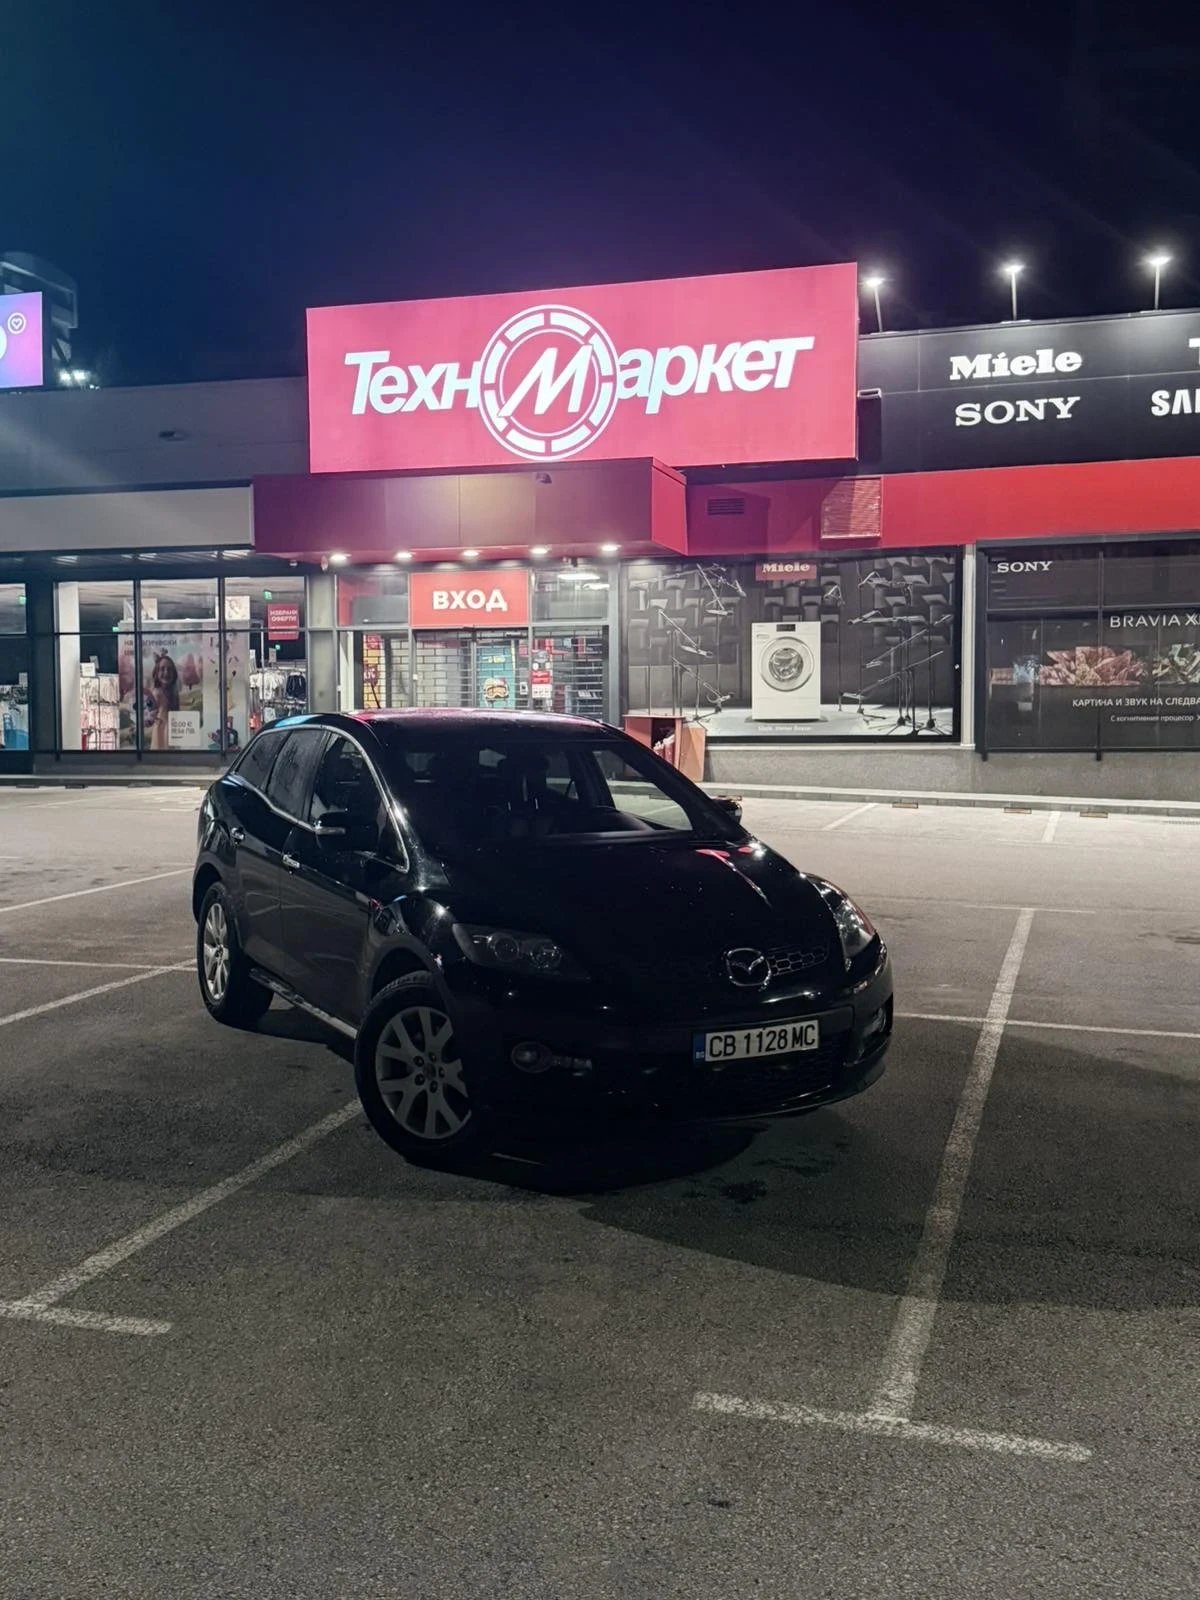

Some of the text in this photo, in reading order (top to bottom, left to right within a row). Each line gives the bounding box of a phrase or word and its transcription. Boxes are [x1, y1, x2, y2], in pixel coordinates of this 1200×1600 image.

[949, 349, 1083, 381] Miele
[955, 396, 1081, 427] SONY
[1151, 389, 1200, 416] SA
[761, 561, 811, 574] Miele
[997, 561, 1053, 573] SONY
[432, 589, 508, 612] ВХОД
[1110, 614, 1182, 628] BRAVIA
[1072, 698, 1114, 707] КАРТИНА
[1115, 698, 1123, 706] И
[1125, 698, 1148, 706] ЗВУК
[1150, 697, 1163, 706] НА
[1160, 715, 1194, 723] процесор
[709, 1024, 816, 1058] CB 1128 MC
